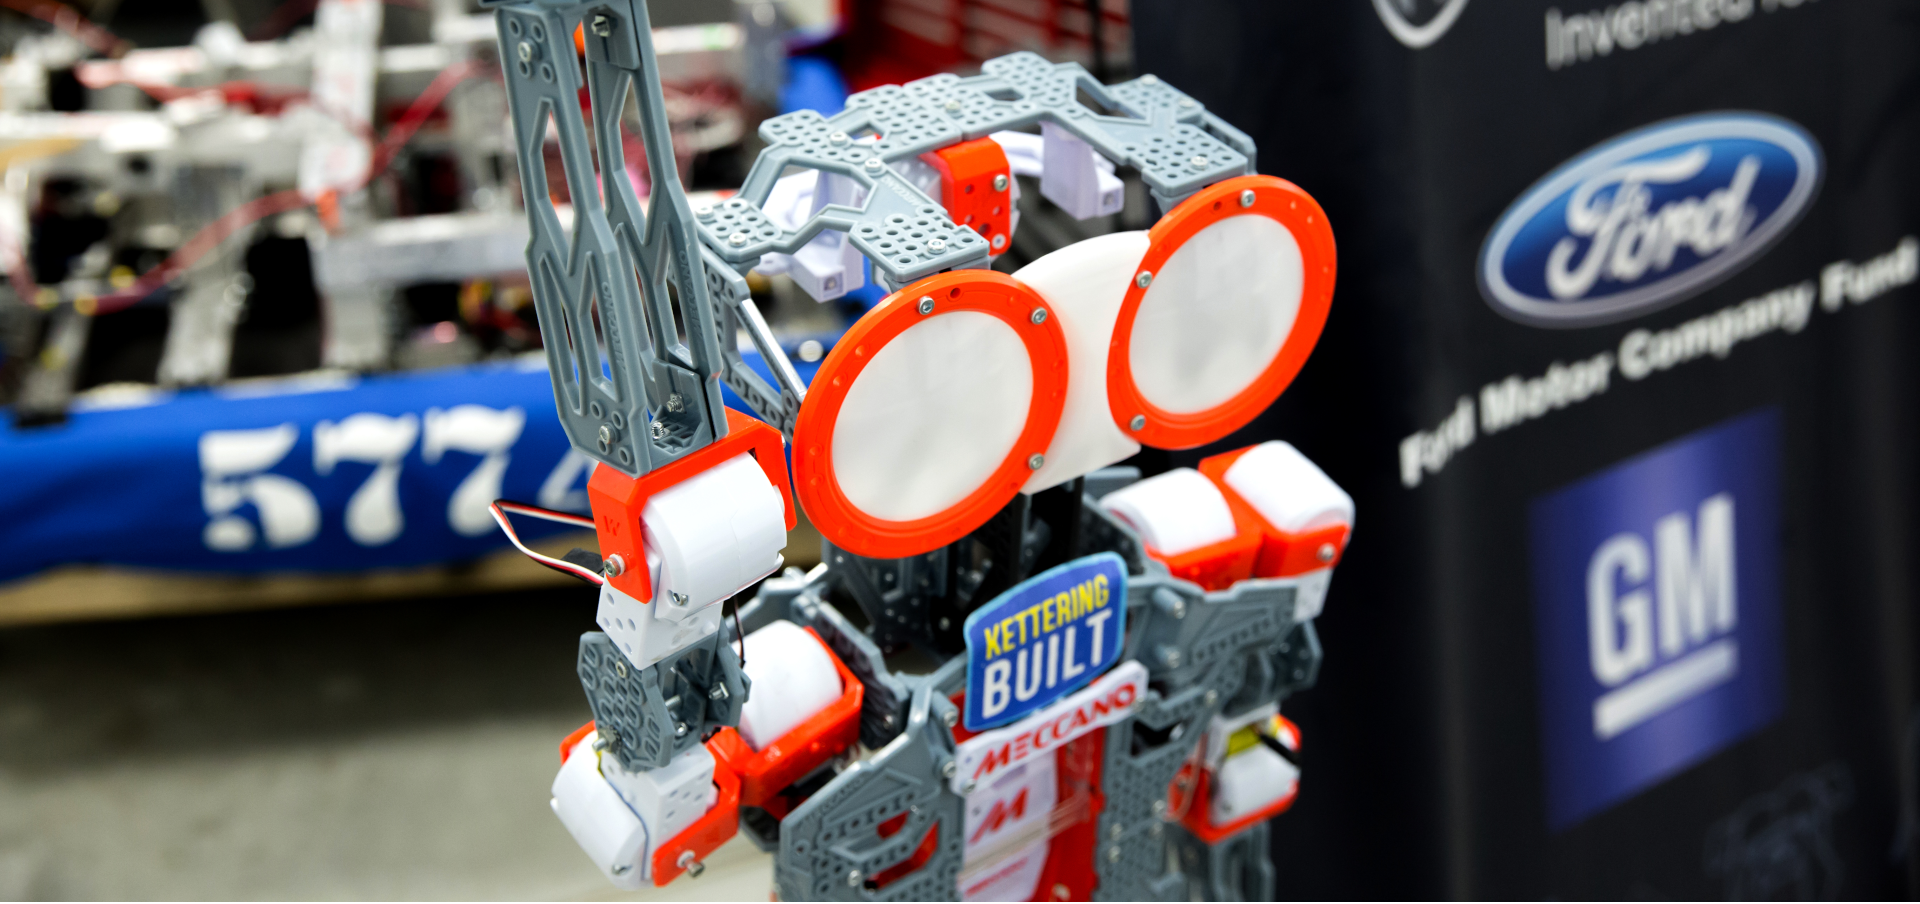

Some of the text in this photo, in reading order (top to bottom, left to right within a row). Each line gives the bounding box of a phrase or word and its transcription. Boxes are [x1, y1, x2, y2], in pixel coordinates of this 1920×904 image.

[1546, 146, 1761, 300] Ford
[1400, 236, 1919, 487] Ford Motor Company Fund
[984, 574, 1109, 660] KETTERING
[1586, 492, 1738, 690] GM
[982, 608, 1112, 719] BUILT
[974, 682, 1137, 780] MECCANO
